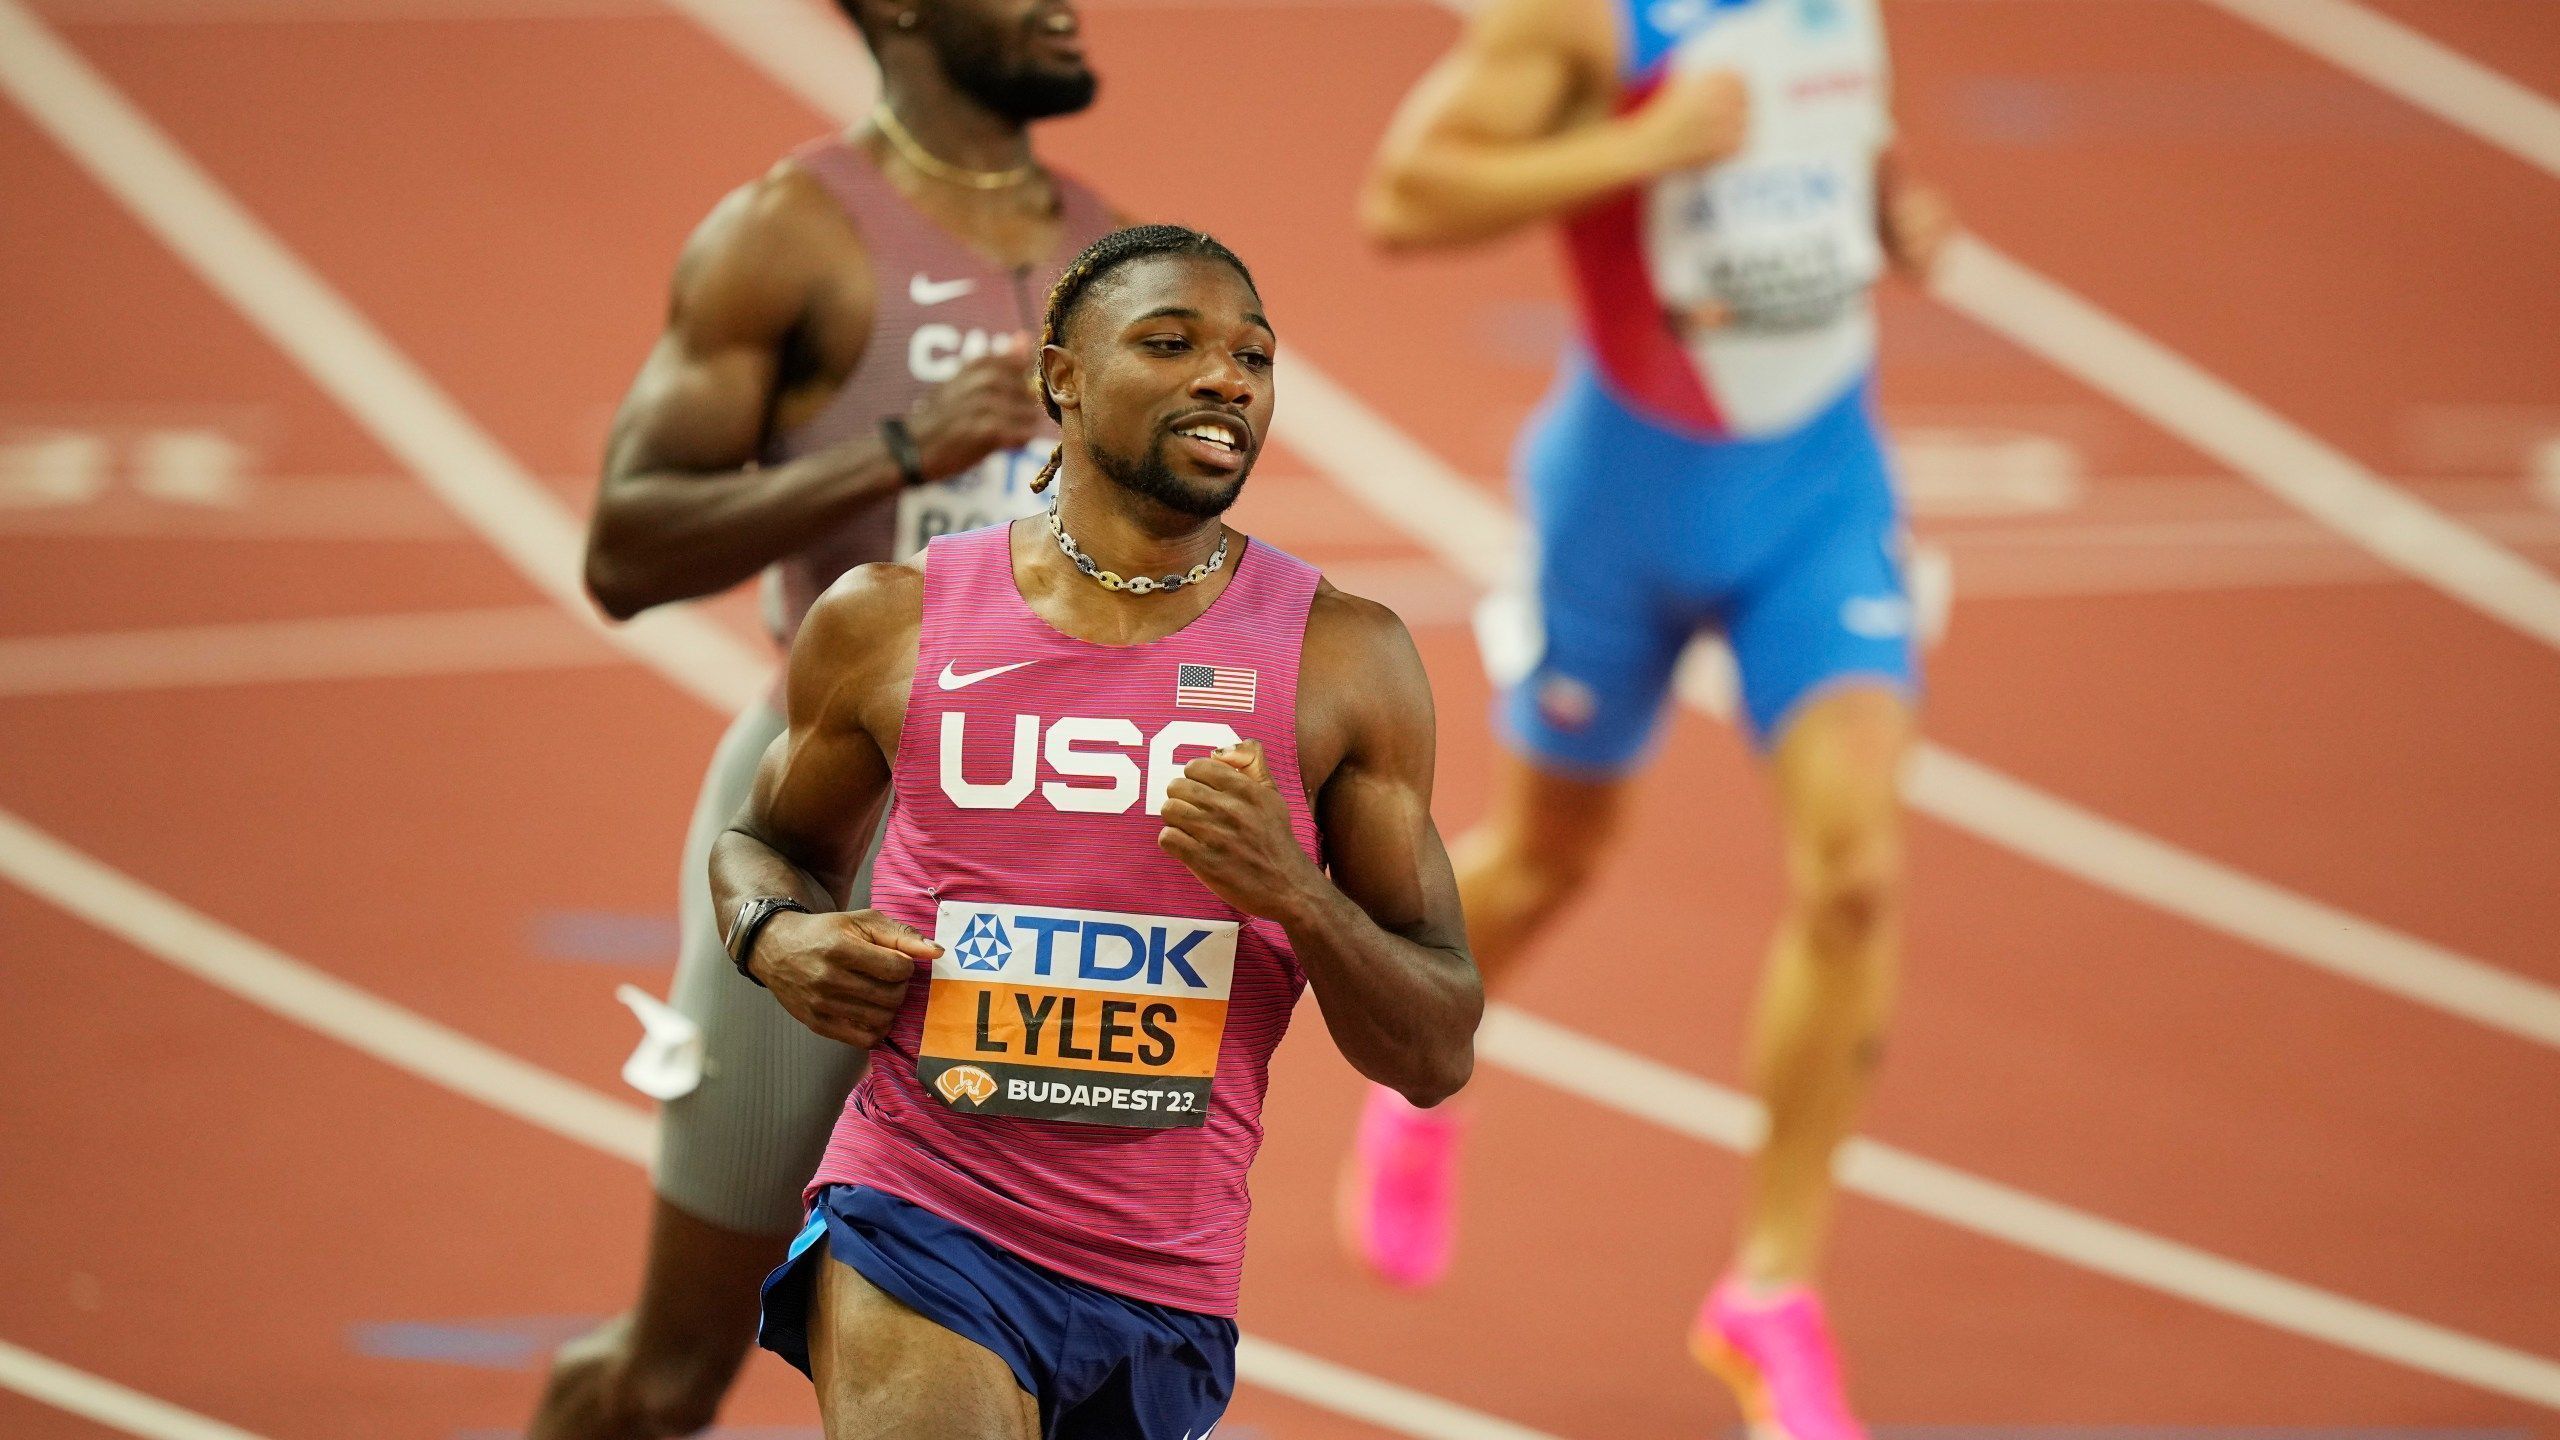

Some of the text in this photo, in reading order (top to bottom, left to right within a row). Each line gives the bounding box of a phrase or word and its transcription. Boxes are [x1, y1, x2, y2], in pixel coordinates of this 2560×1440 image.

[1014, 915, 1213, 988] TDK
[975, 989, 1177, 1066] LYLES
[1007, 1079, 1195, 1111] BUDAPEST 23
